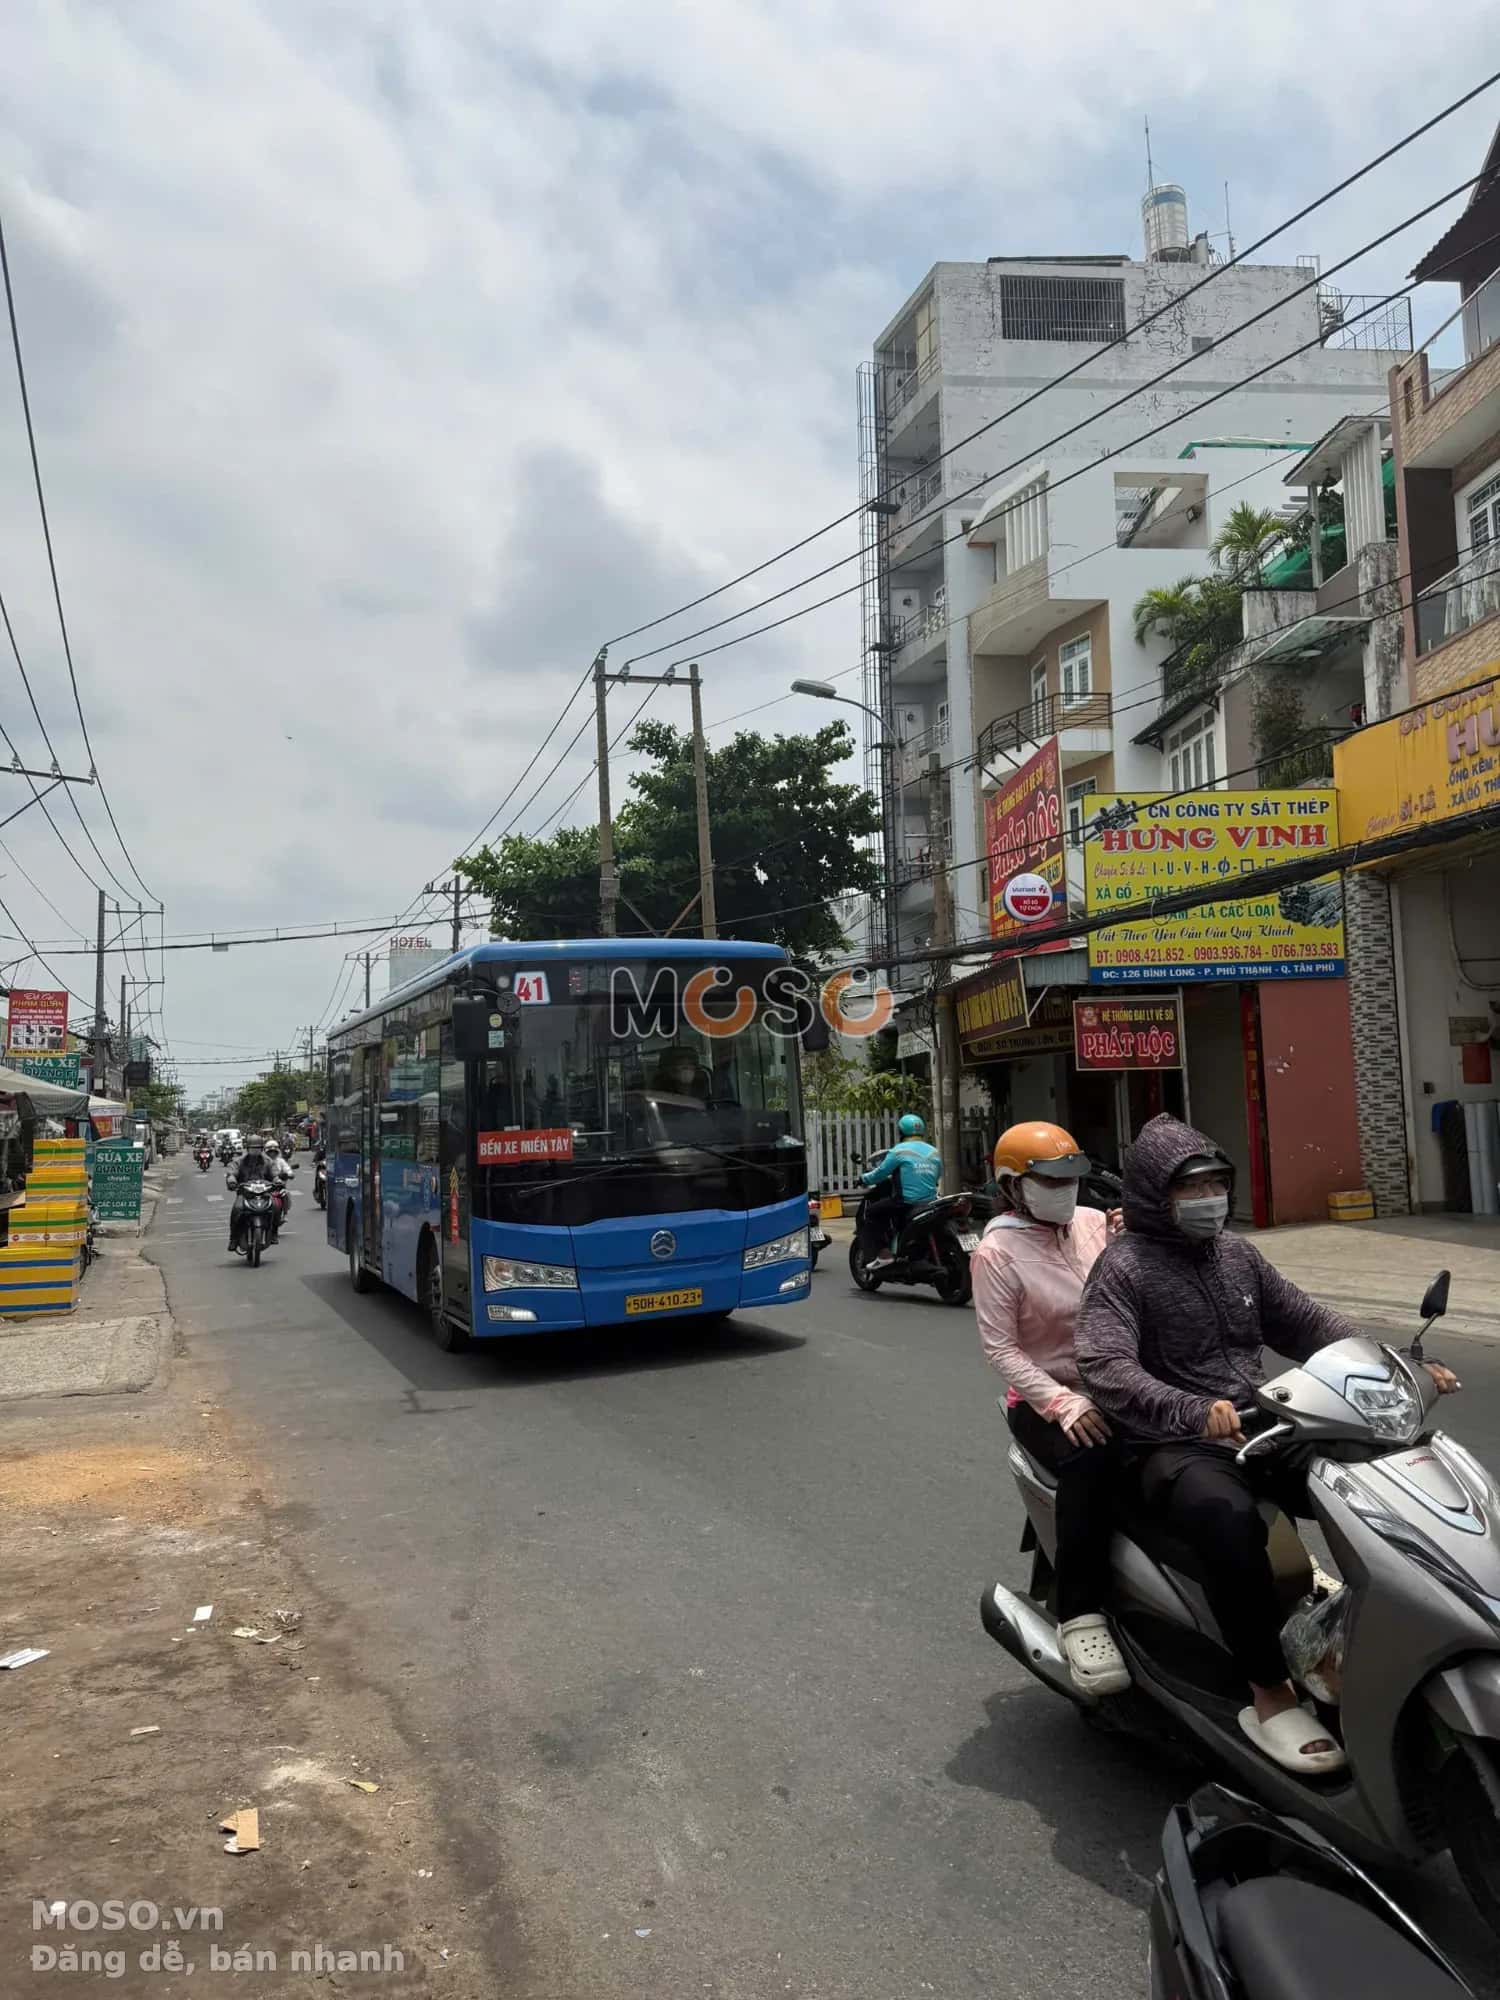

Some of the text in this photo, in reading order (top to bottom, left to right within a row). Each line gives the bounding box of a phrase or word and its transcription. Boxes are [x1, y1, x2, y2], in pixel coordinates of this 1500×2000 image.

[1148, 796, 1330, 818] CN CÔNG TY SẮT THÉP
[990, 815, 1026, 884] PHÁT
[1027, 789, 1060, 862] LỘC
[1102, 823, 1328, 852] HƯNG VINH
[390, 937, 432, 949] HOTEL
[1122, 970, 1141, 978] 126
[1169, 967, 1196, 977] LONG
[1203, 968, 1214, 976] P.
[516, 976, 543, 1001] 41
[1083, 1025, 1175, 1063] PHÁT LỘC
[58, 1057, 78, 1068] XE
[480, 1138, 502, 1156] BẾN
[504, 1141, 518, 1154] XE
[551, 1137, 569, 1152] TÂY
[126, 1152, 143, 1163] XE
[633, 1292, 697, 1310] 50H-410.23
